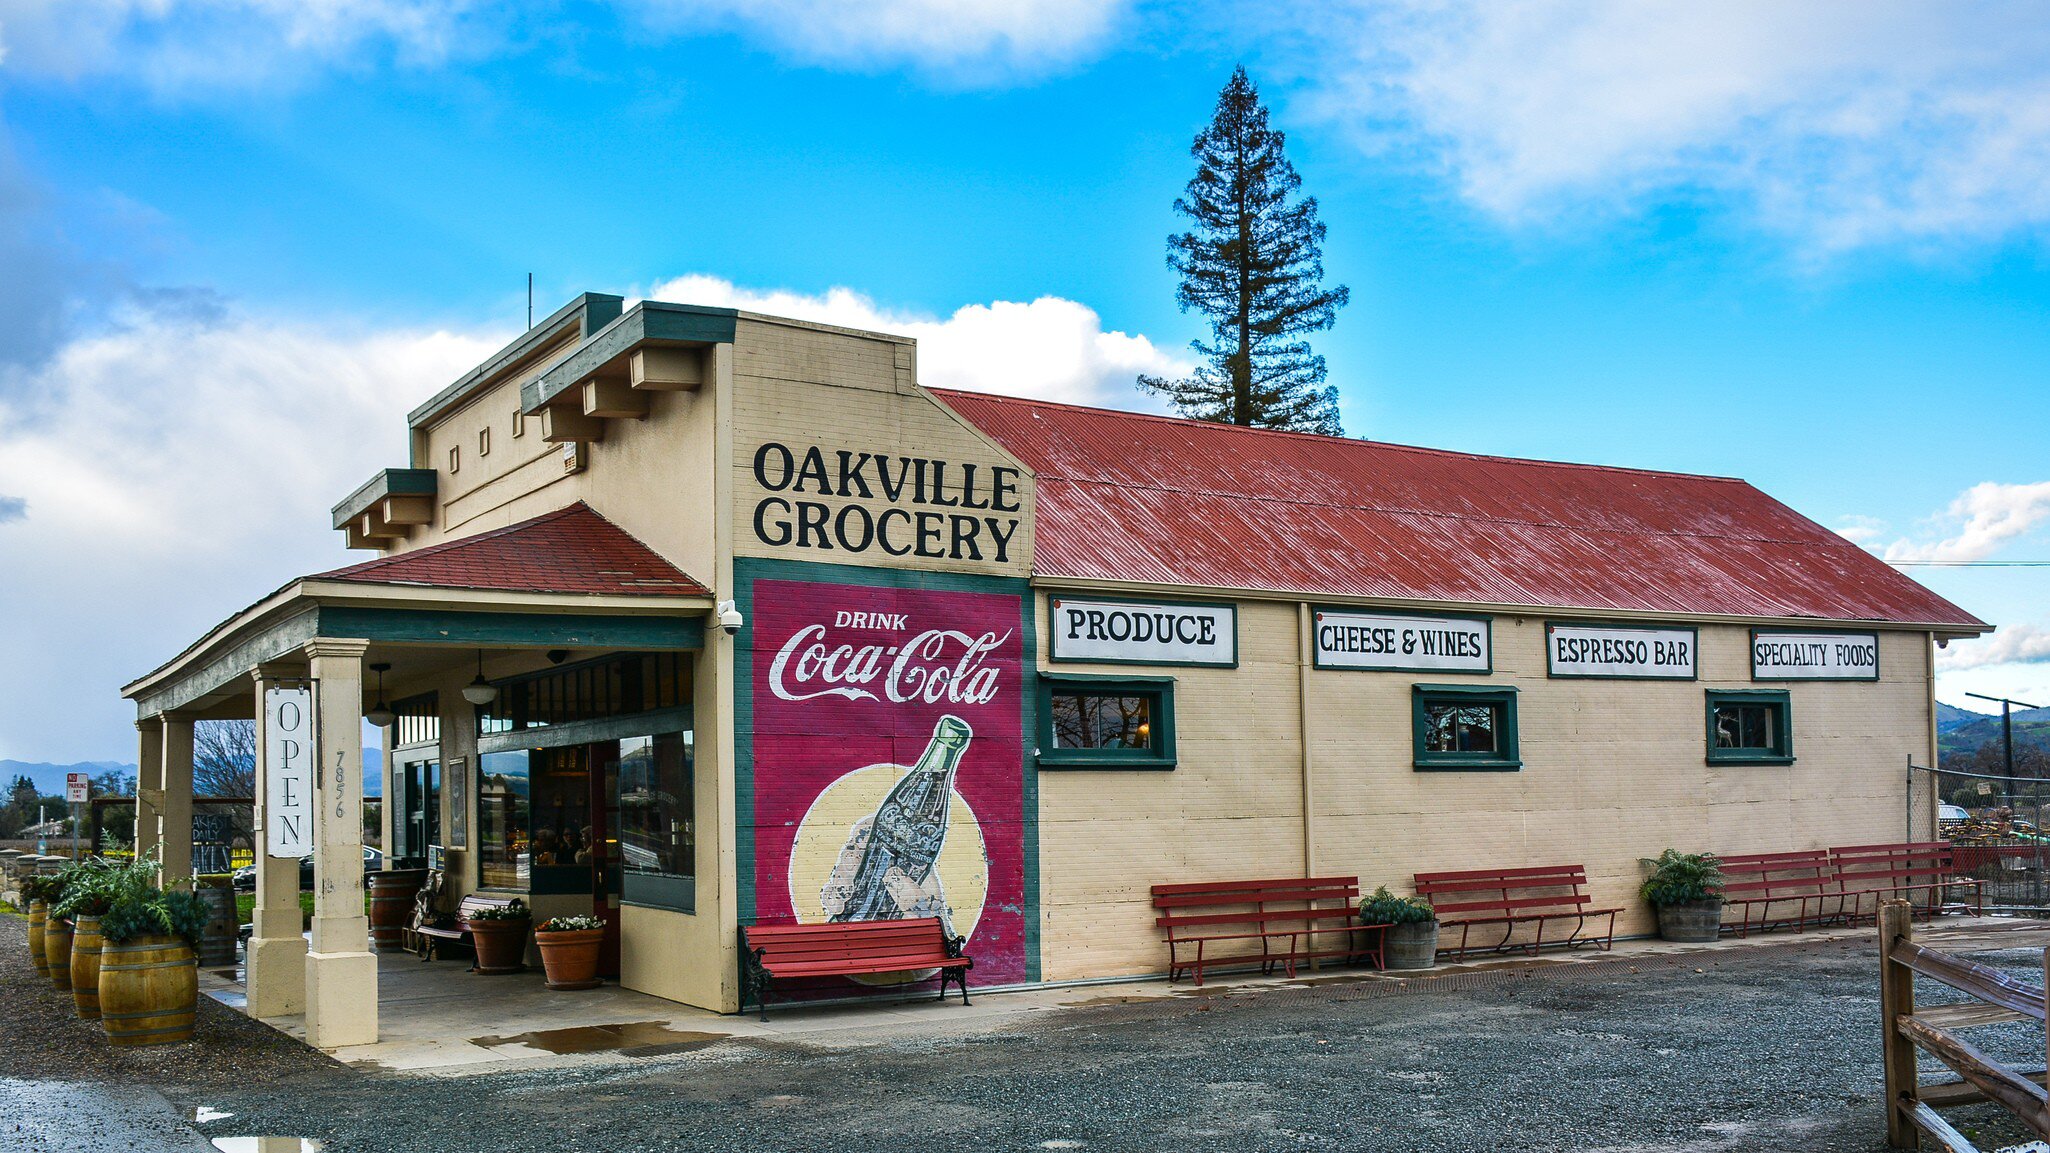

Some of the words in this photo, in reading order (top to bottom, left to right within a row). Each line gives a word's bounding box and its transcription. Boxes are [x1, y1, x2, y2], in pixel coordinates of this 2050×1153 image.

[753, 442, 1020, 512] OAKVILLE
[753, 497, 1019, 562] GROCERY
[834, 611, 908, 631] DRINK
[1066, 608, 1216, 645] PRODUCE
[1319, 625, 1396, 654] CHEESE
[1402, 628, 1417, 655] &
[1419, 629, 1481, 658] WINES
[1556, 637, 1648, 665] ESPRESSO
[1654, 640, 1689, 666] BAR
[1755, 643, 1828, 666] SPECIALITY
[1835, 644, 1875, 666] FOODS
[768, 624, 1013, 704] Coca-Cola
[277, 702, 301, 845] OPEN
[335, 751, 346, 818] 7856
[192, 829, 220, 840] DAILY
